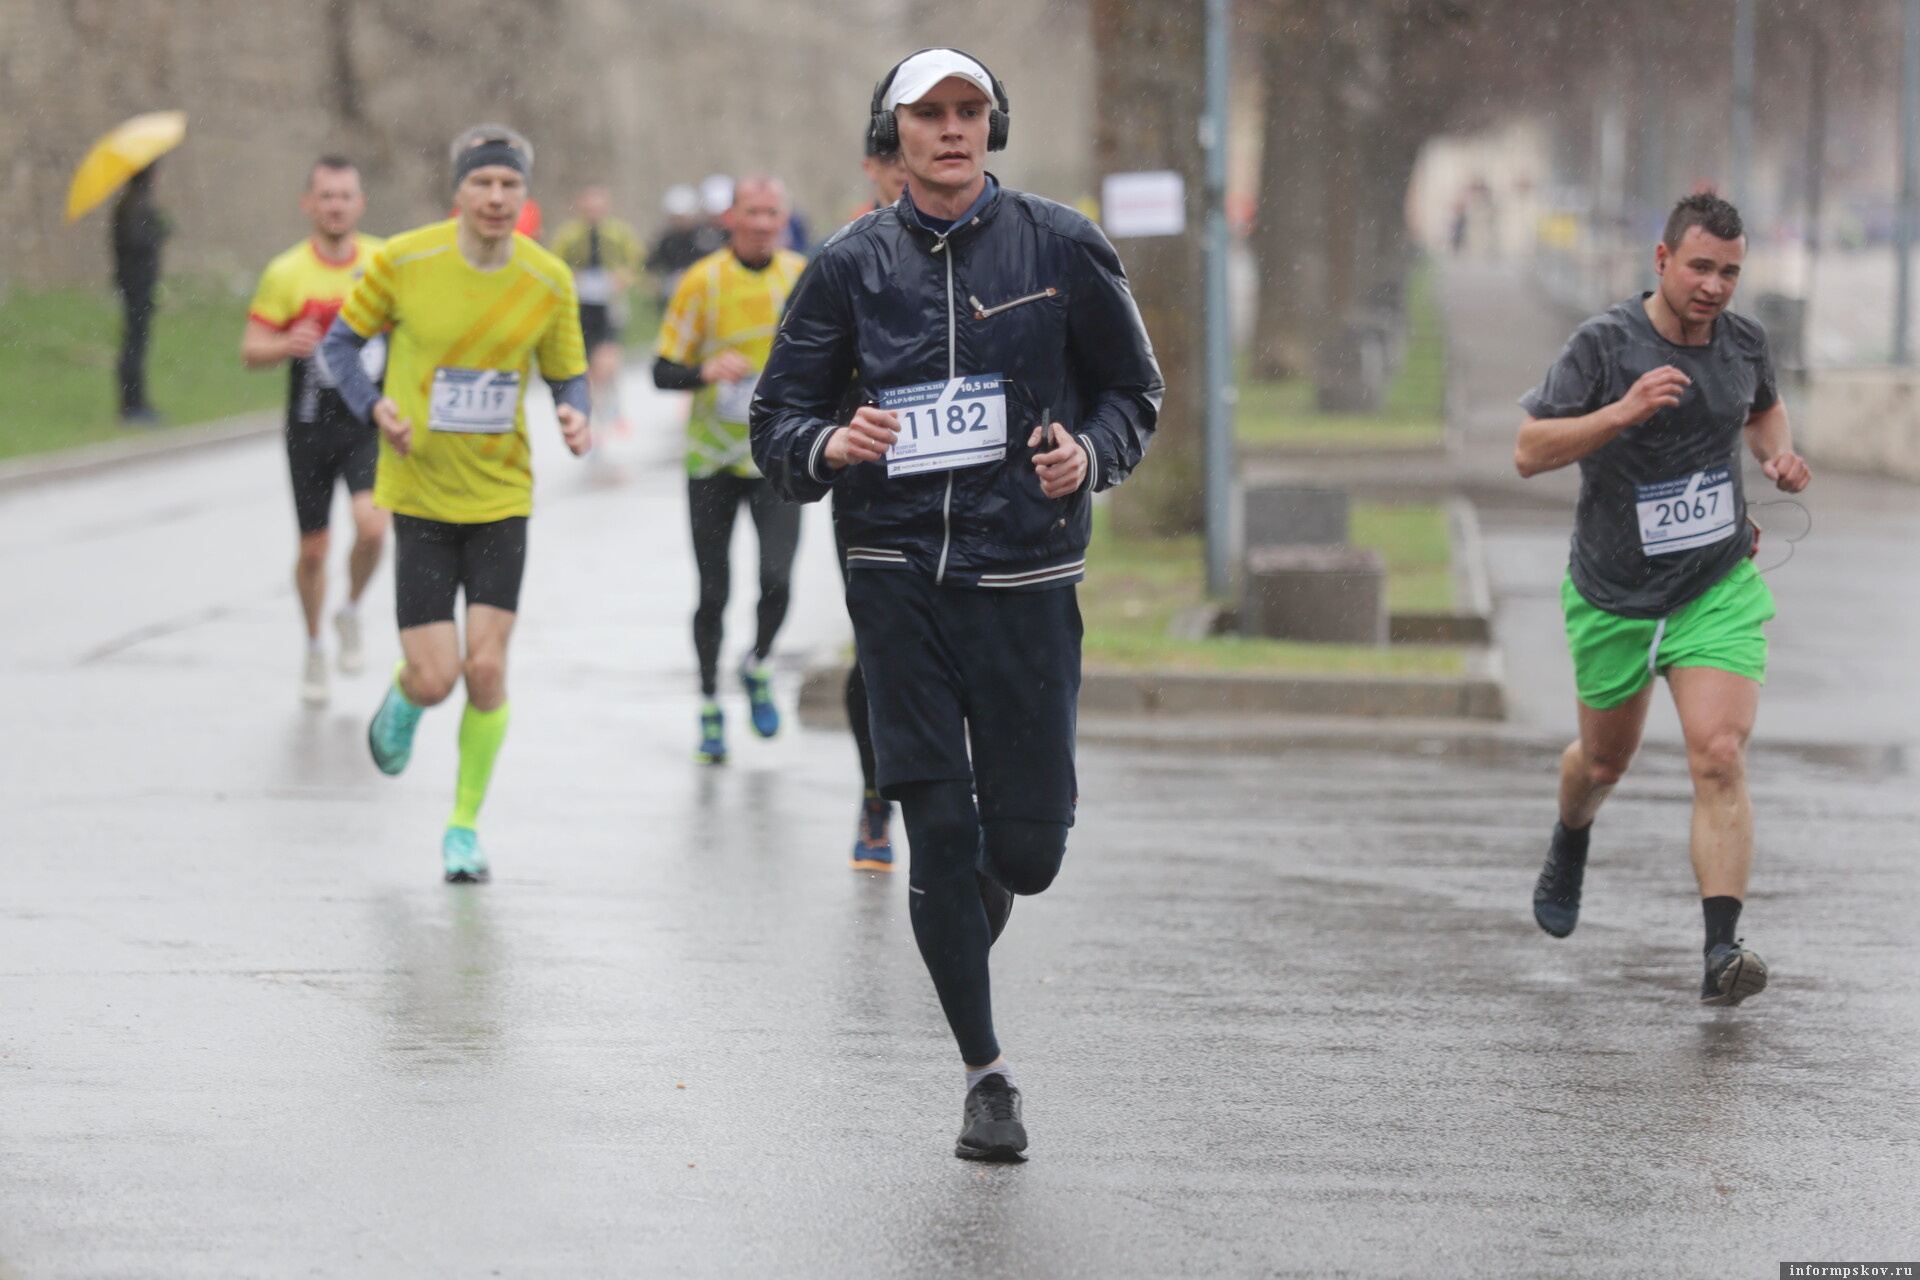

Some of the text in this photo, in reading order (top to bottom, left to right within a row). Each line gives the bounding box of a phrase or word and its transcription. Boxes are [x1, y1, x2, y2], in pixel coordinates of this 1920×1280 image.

[960, 381, 982, 393] 10,5
[448, 389, 505, 409] 2119
[885, 395, 925, 406] МАРАФОН
[905, 402, 988, 440] 1182
[1655, 492, 1719, 527] 2067
